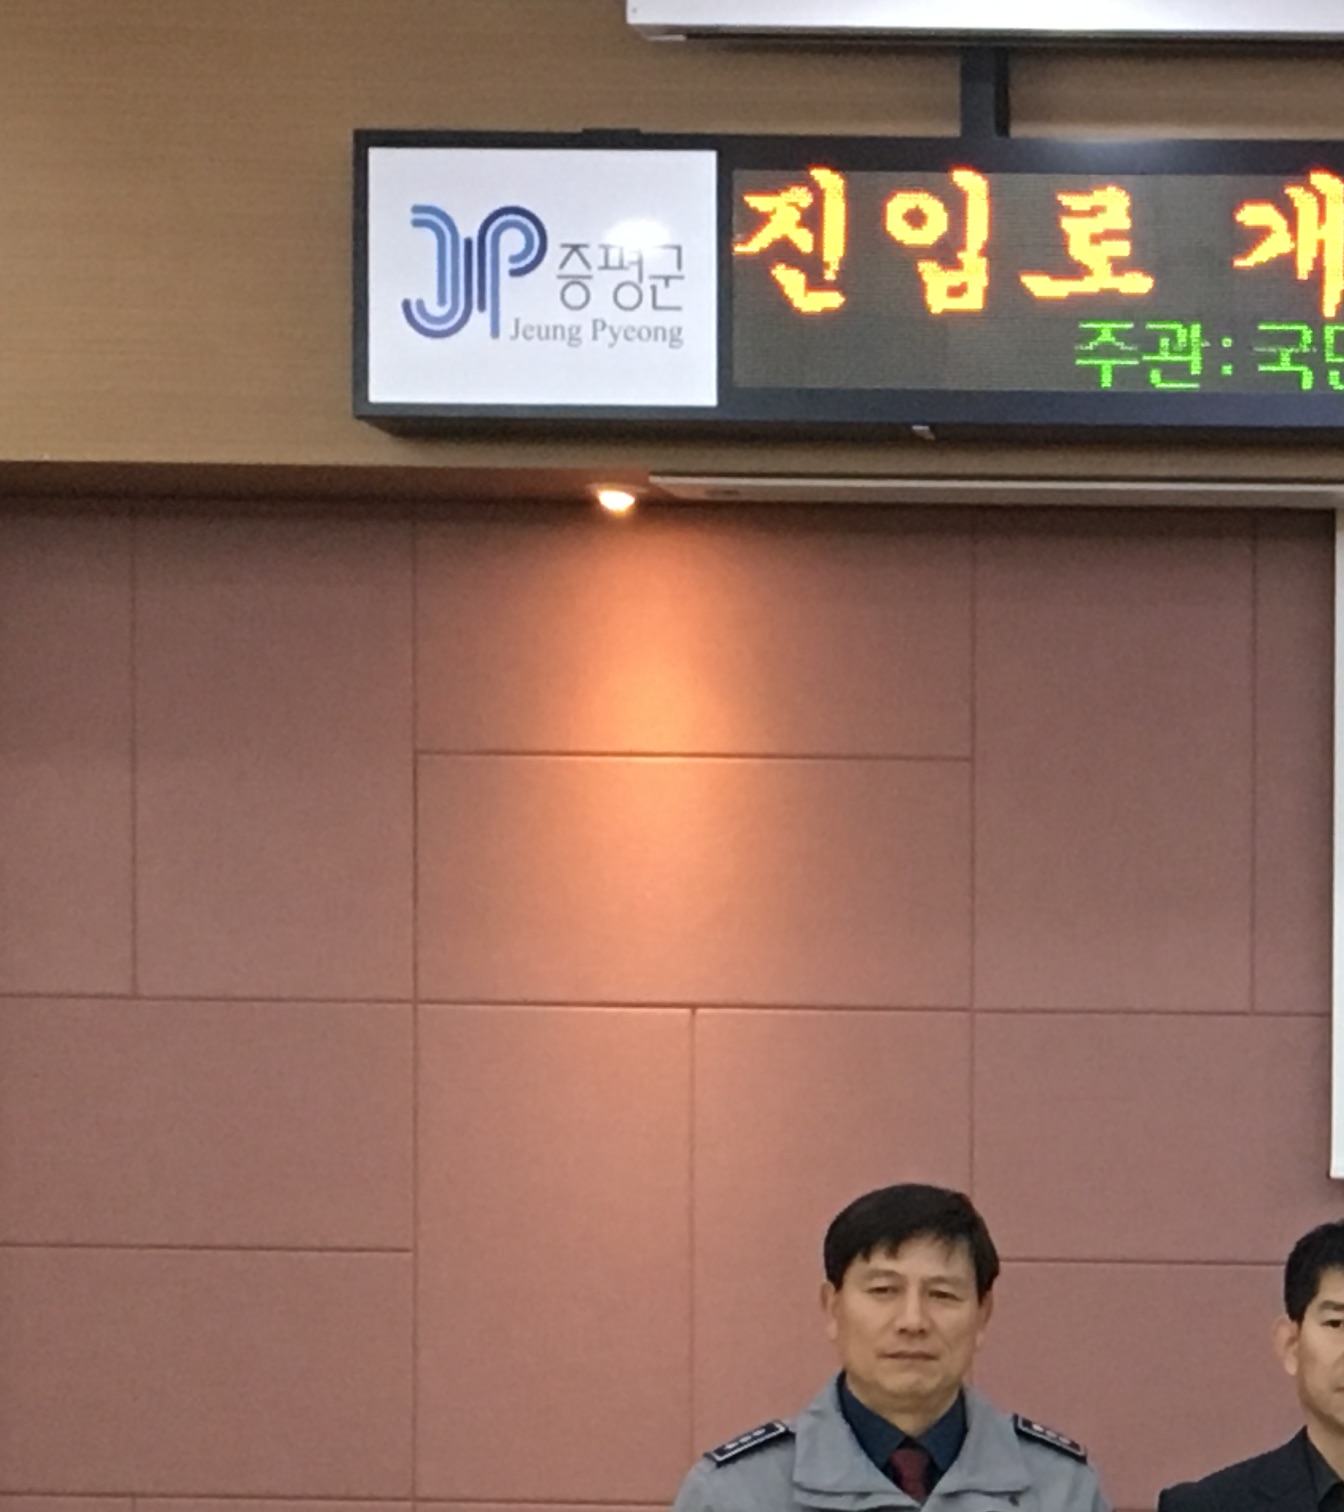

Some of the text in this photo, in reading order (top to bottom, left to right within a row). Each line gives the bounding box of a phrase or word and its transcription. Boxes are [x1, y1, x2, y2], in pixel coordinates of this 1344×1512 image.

[732, 166, 1155, 314] 진입로
[556, 242, 686, 312] 증평군
[509, 317, 685, 347] Jeung Pyeong
